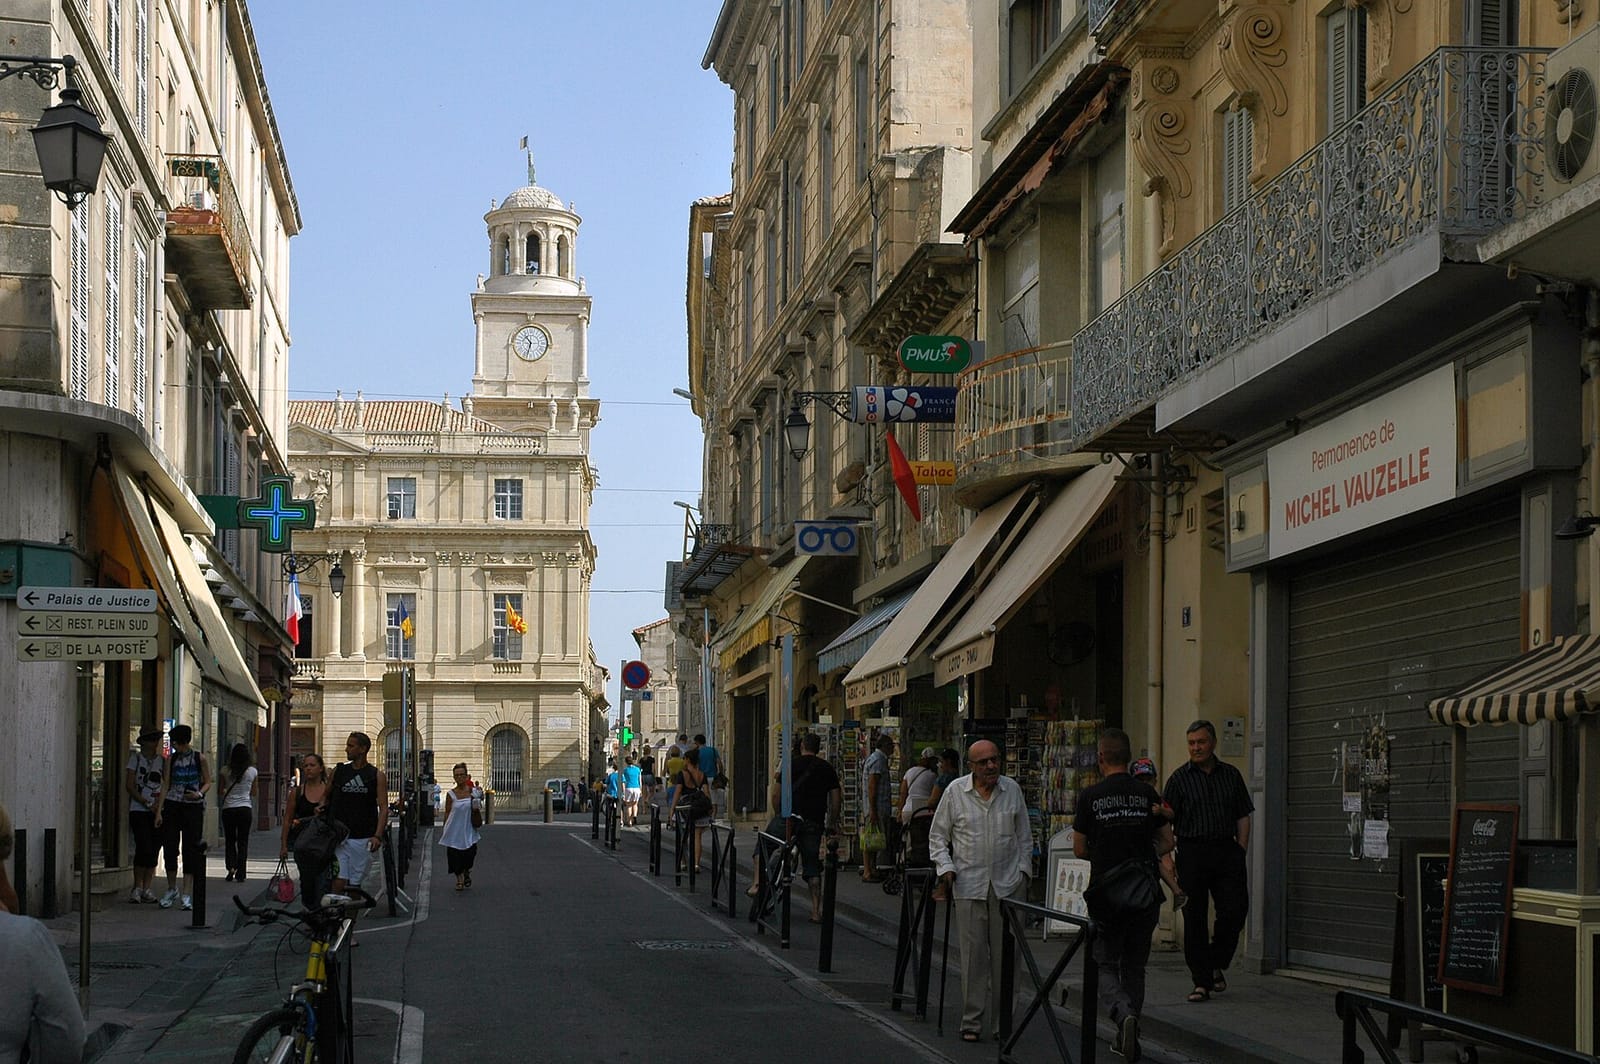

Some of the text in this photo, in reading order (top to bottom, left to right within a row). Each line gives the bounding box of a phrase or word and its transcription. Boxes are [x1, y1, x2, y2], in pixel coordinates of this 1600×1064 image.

[906, 348, 940, 362] PMU
[1312, 419, 1395, 473] Permanence de
[914, 465, 953, 477] Tabac
[1285, 446, 1430, 530] MICHEL VAUZELLE
[46, 593, 150, 607] Palais de Justice
[67, 618, 149, 631] REST. PLEIN SUD
[66, 643, 82, 655] DE
[86, 643, 102, 655] LA
[341, 785, 369, 794] adidas
[1092, 793, 1129, 812] ORIGINAL
